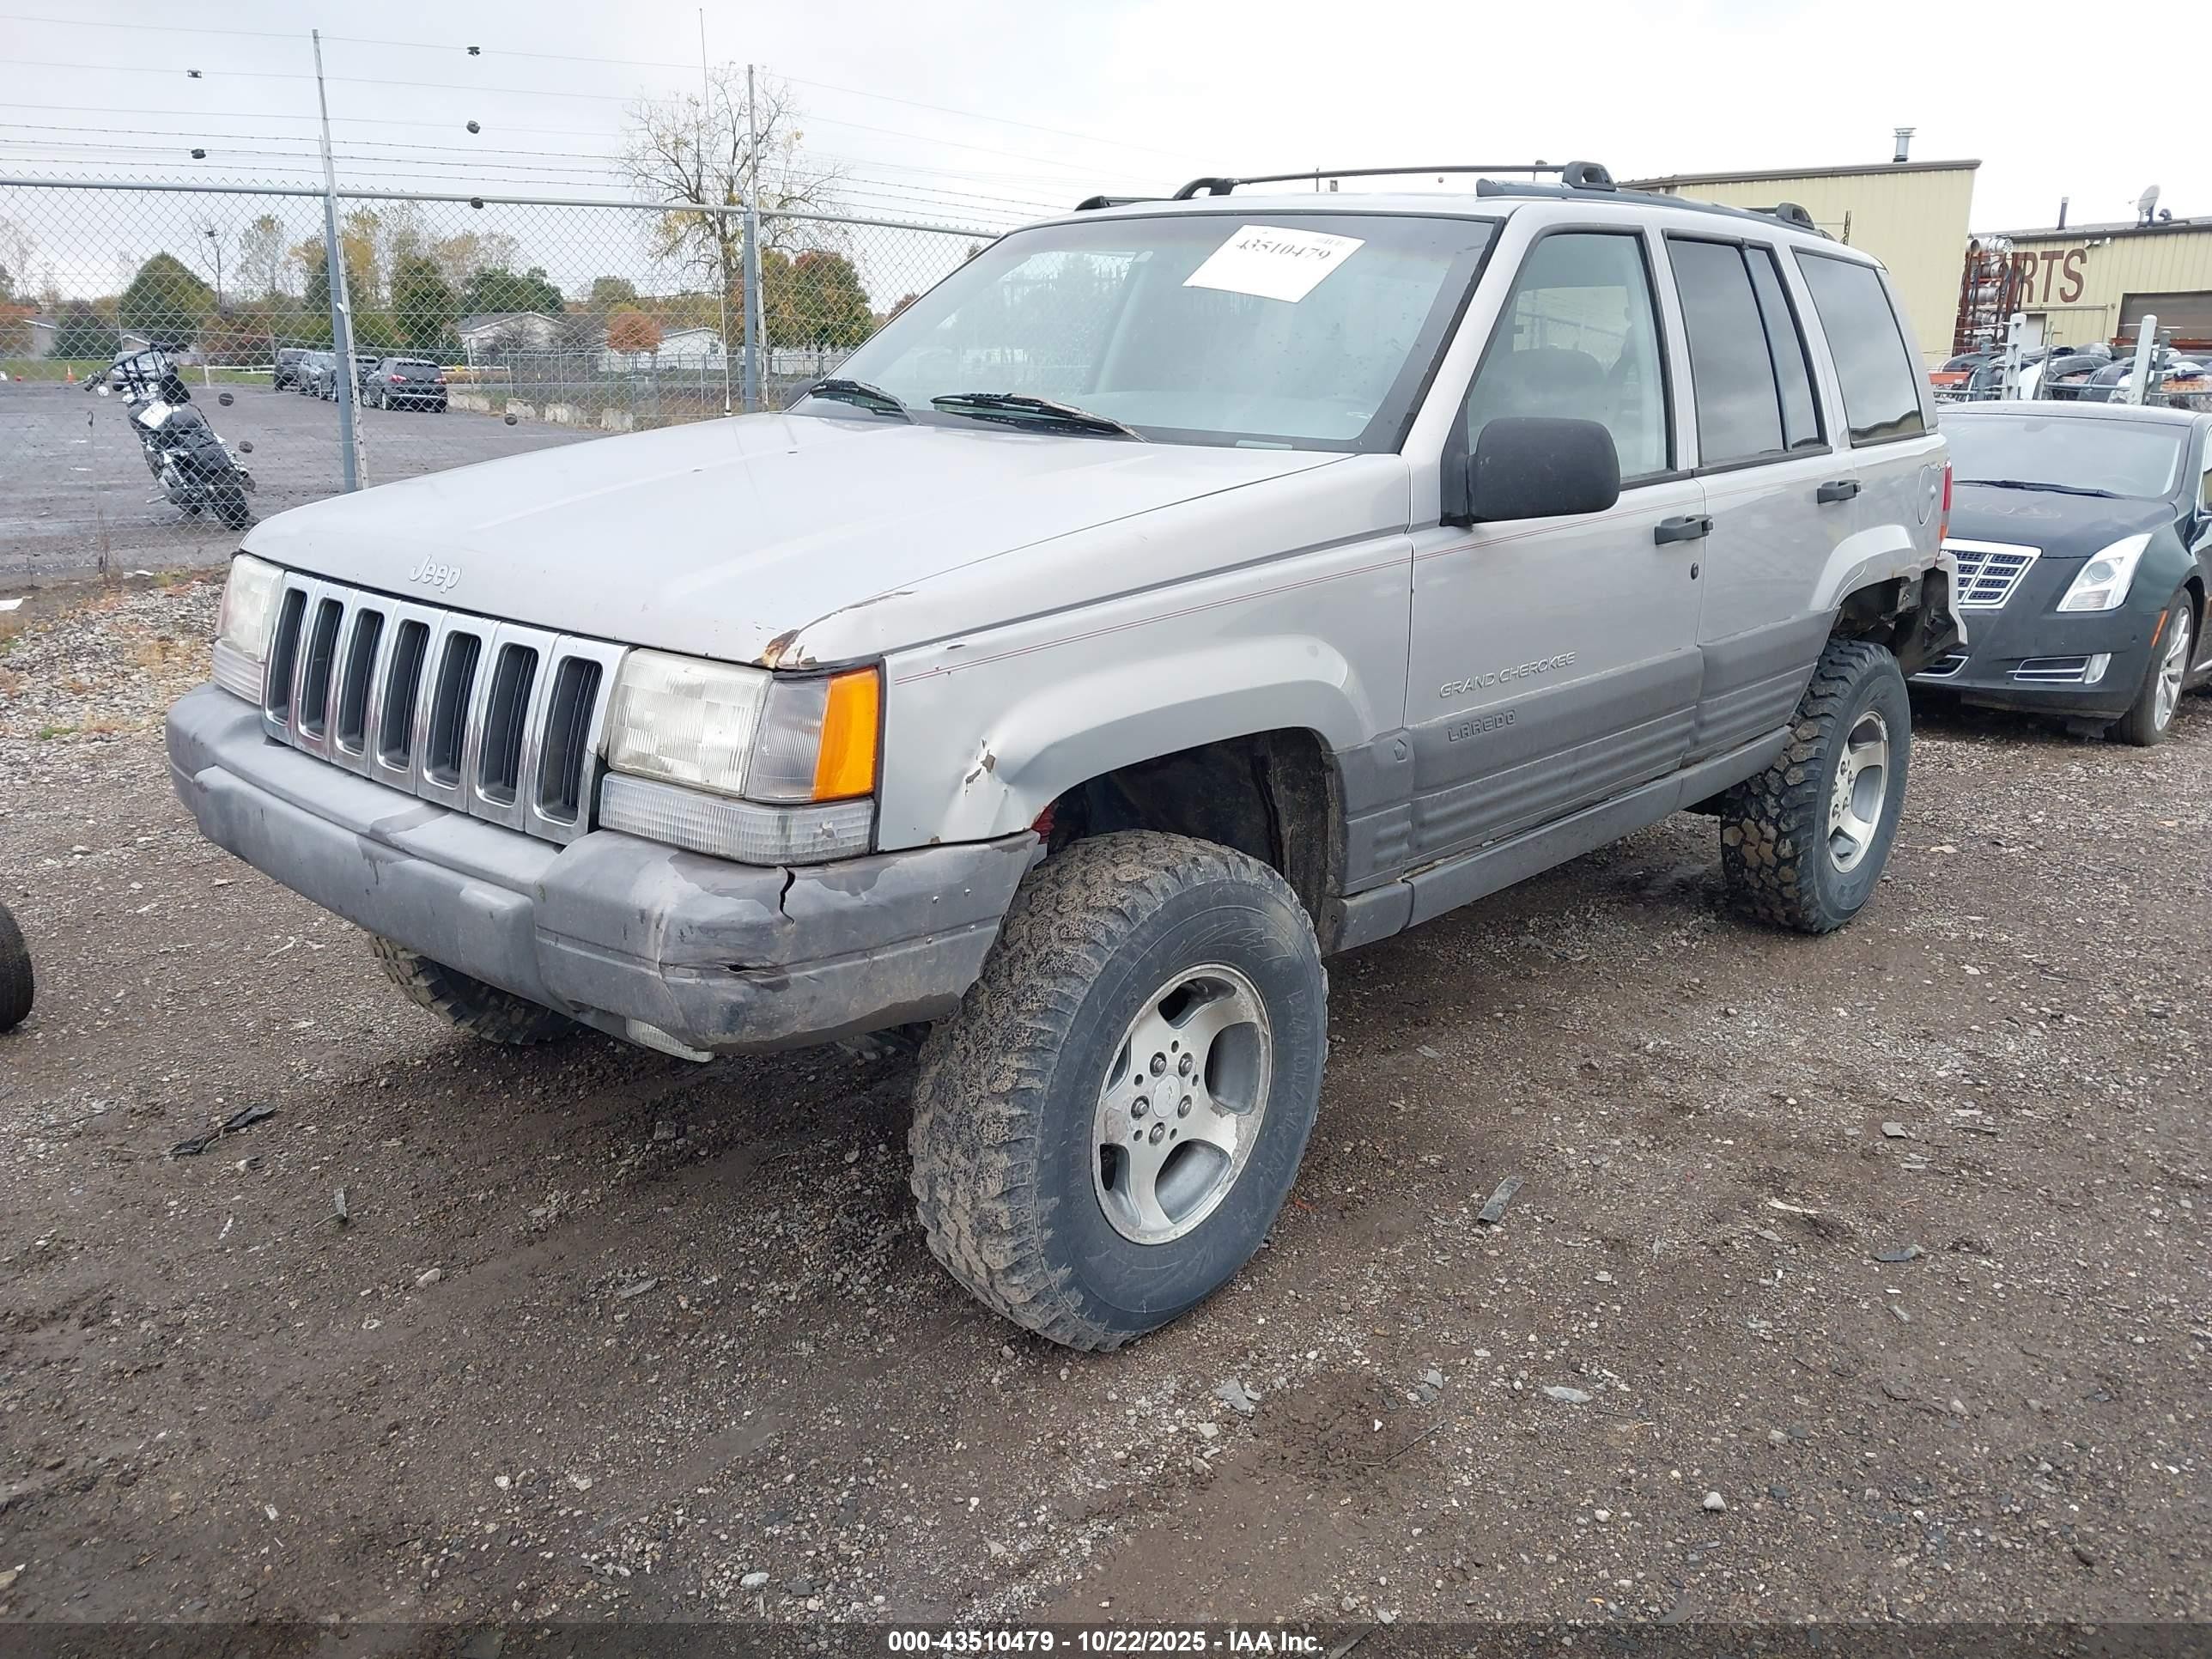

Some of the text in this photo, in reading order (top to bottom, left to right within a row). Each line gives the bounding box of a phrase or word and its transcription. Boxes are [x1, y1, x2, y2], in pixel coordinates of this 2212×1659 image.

[409, 556, 462, 593] Jeep
[1439, 651, 1577, 698] GRAND CHEROKEE
[1448, 708, 1516, 743] LAREDO
